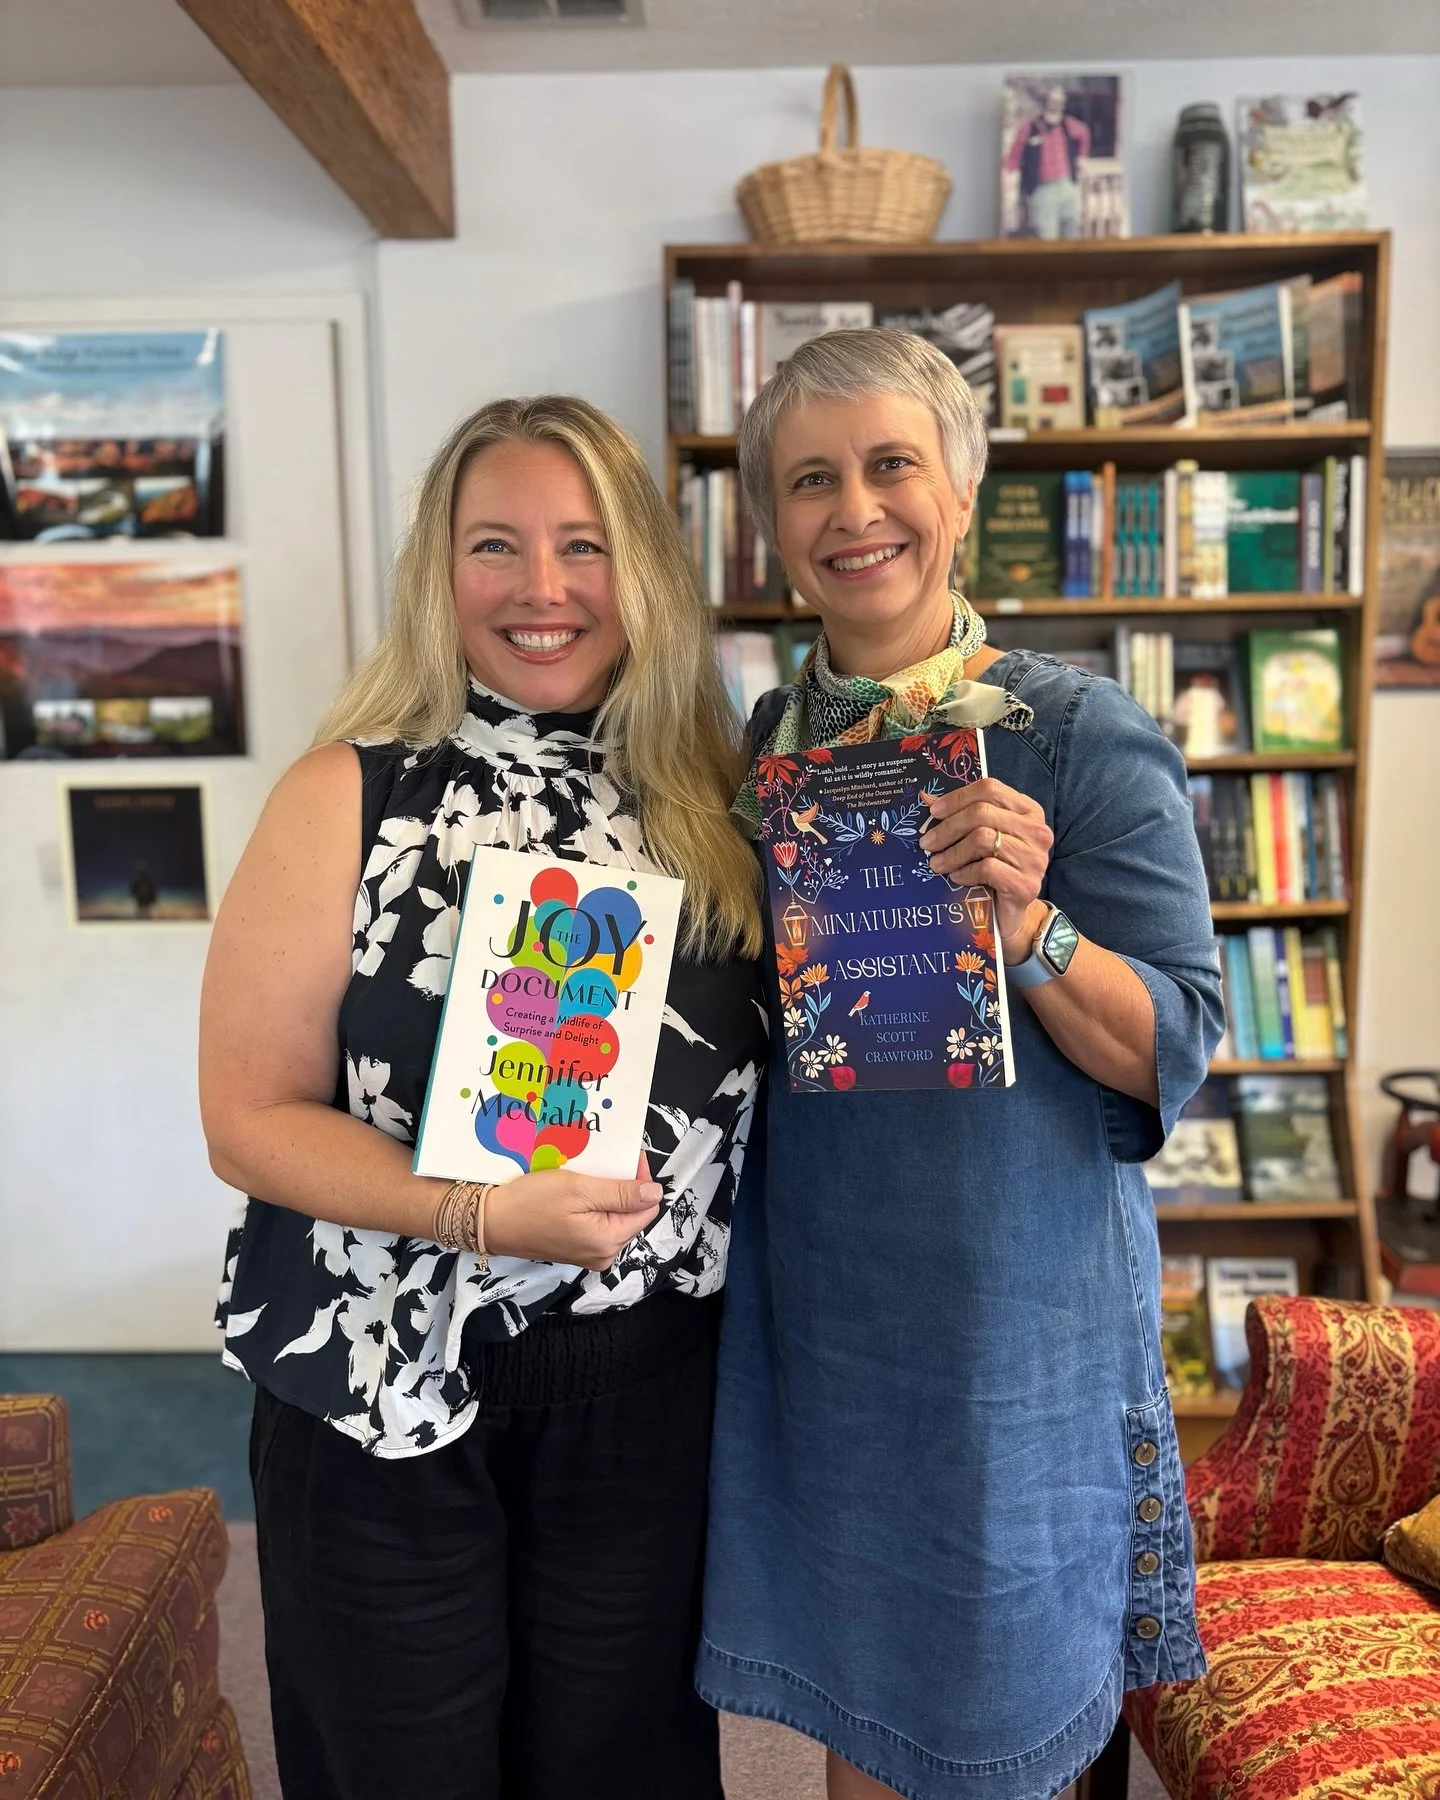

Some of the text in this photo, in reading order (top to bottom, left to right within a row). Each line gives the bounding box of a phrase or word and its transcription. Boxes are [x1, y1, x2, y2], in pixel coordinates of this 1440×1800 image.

[854, 770, 874, 780] wildly
[861, 761, 877, 771] story
[886, 758, 916, 766] suspense-
[832, 795, 846, 803] Deep
[858, 792, 865, 800] of
[866, 790, 874, 798] the
[858, 799, 891, 807] Birdwatcher
[860, 864, 904, 889] THE
[811, 902, 964, 937] MINIATURIST'S
[489, 900, 648, 976] JOY
[556, 930, 582, 945] THE
[833, 951, 951, 981] ASSISTANT
[481, 968, 637, 1011] DOCUMENT
[505, 1007, 547, 1025] Creating
[556, 1015, 590, 1028] Midlife
[592, 1020, 604, 1030] of
[859, 1011, 930, 1026] KATHERINE
[503, 1021, 600, 1047] Surprise and Delight
[876, 1030, 917, 1044] SCOTT
[865, 1049, 934, 1063] CRAWFORD
[478, 1051, 610, 1093] Jennifer
[470, 1088, 602, 1134] McGaha
